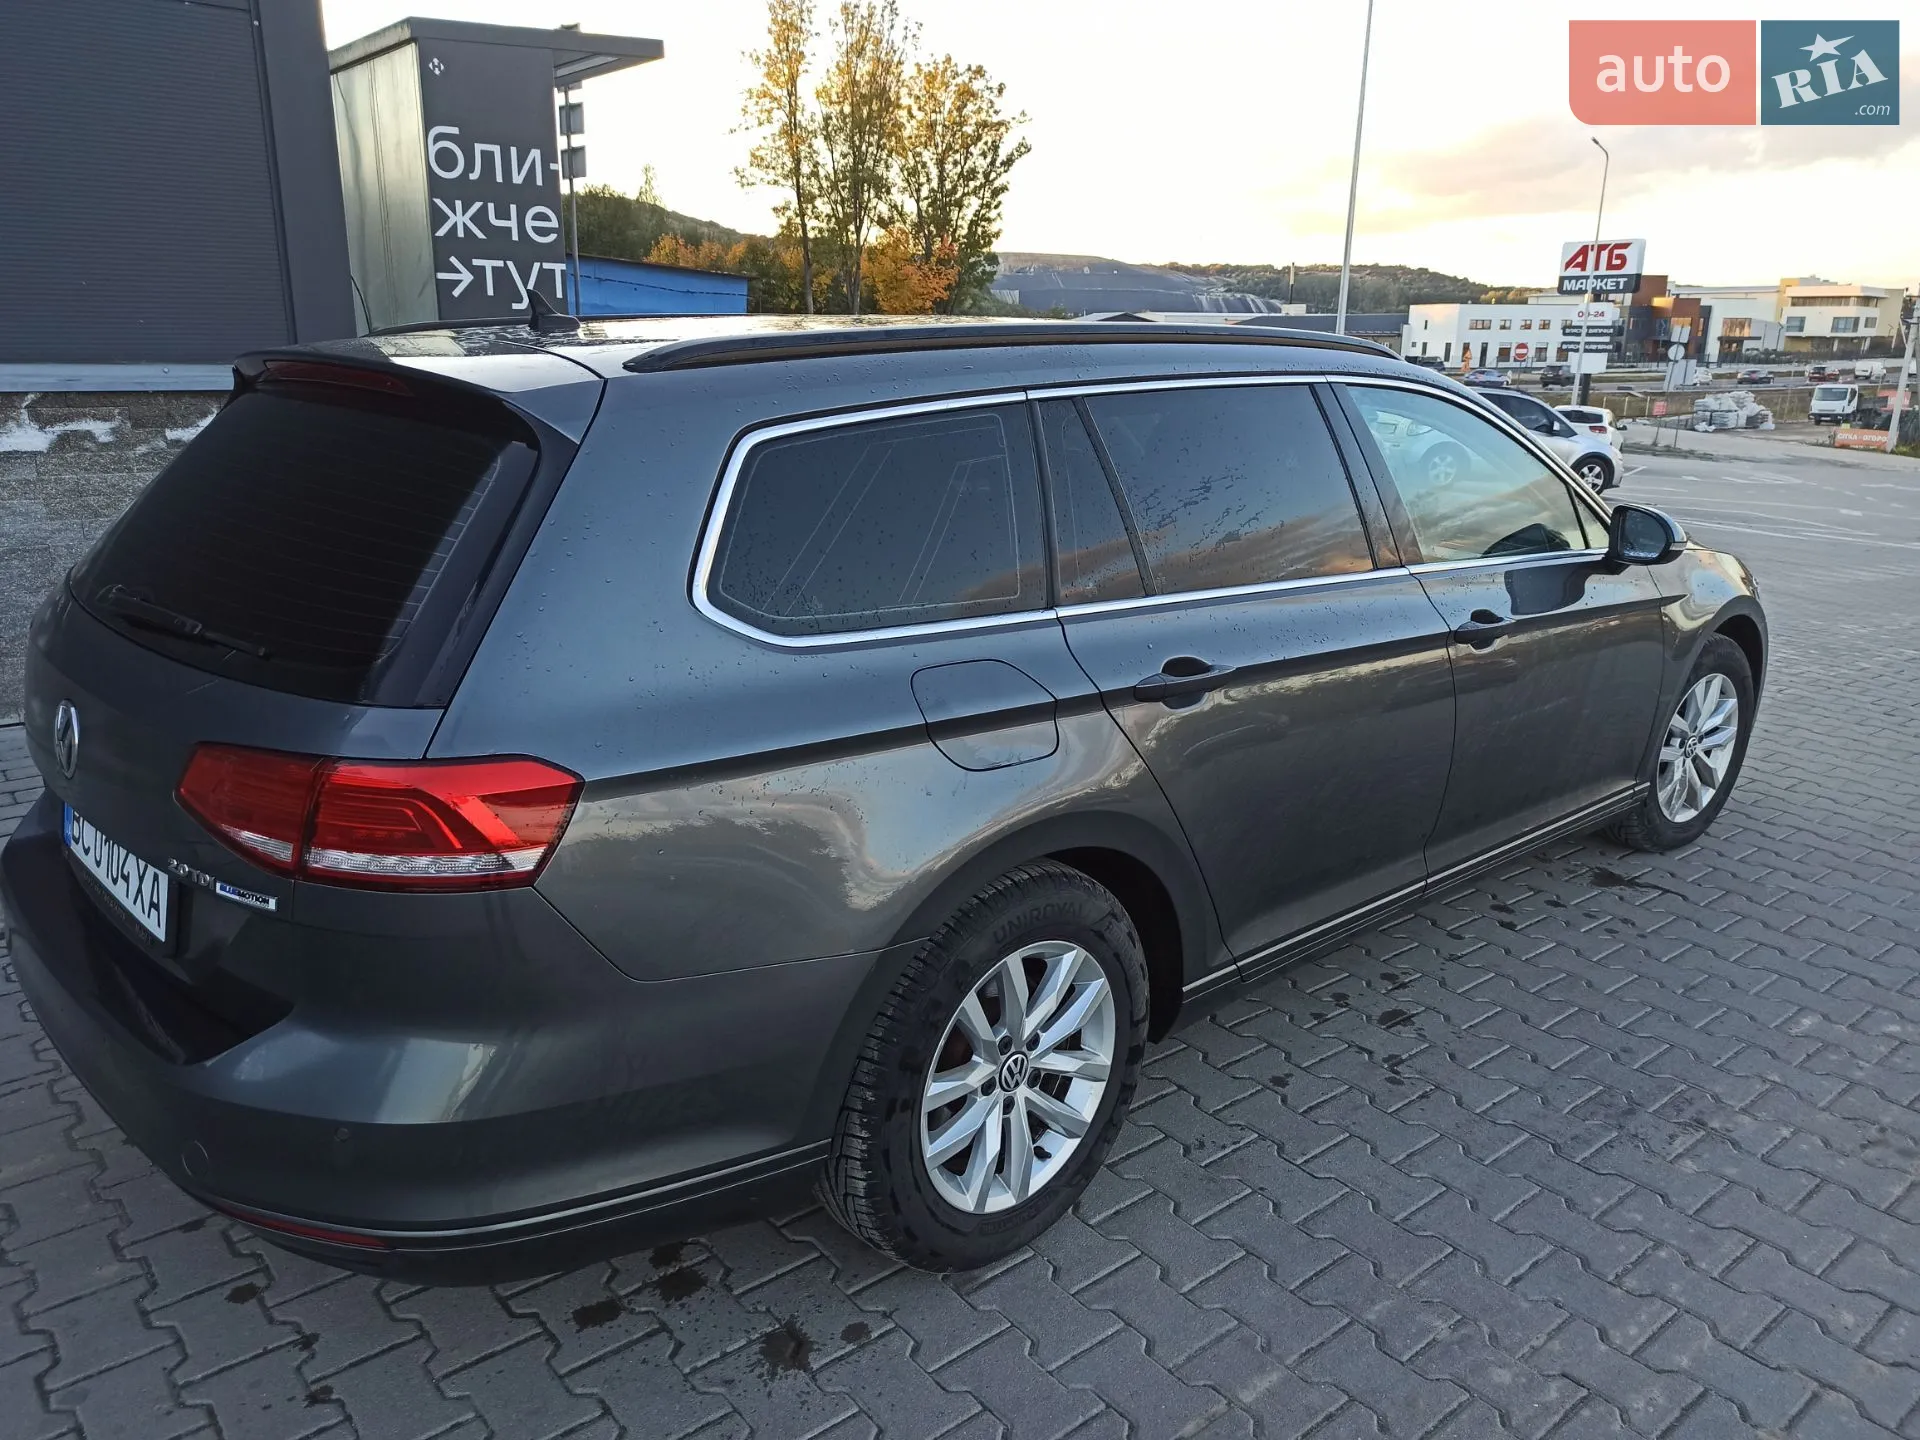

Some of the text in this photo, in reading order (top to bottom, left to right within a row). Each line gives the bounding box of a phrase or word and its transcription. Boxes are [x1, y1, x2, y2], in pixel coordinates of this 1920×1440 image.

[427, 125, 560, 186] бли-
[432, 198, 559, 243] жче
[1564, 242, 1633, 272] АТБ
[472, 258, 566, 310] тут
[1562, 277, 1628, 291] МАРКЕТ
[994, 901, 1087, 943] UNIROYAL
